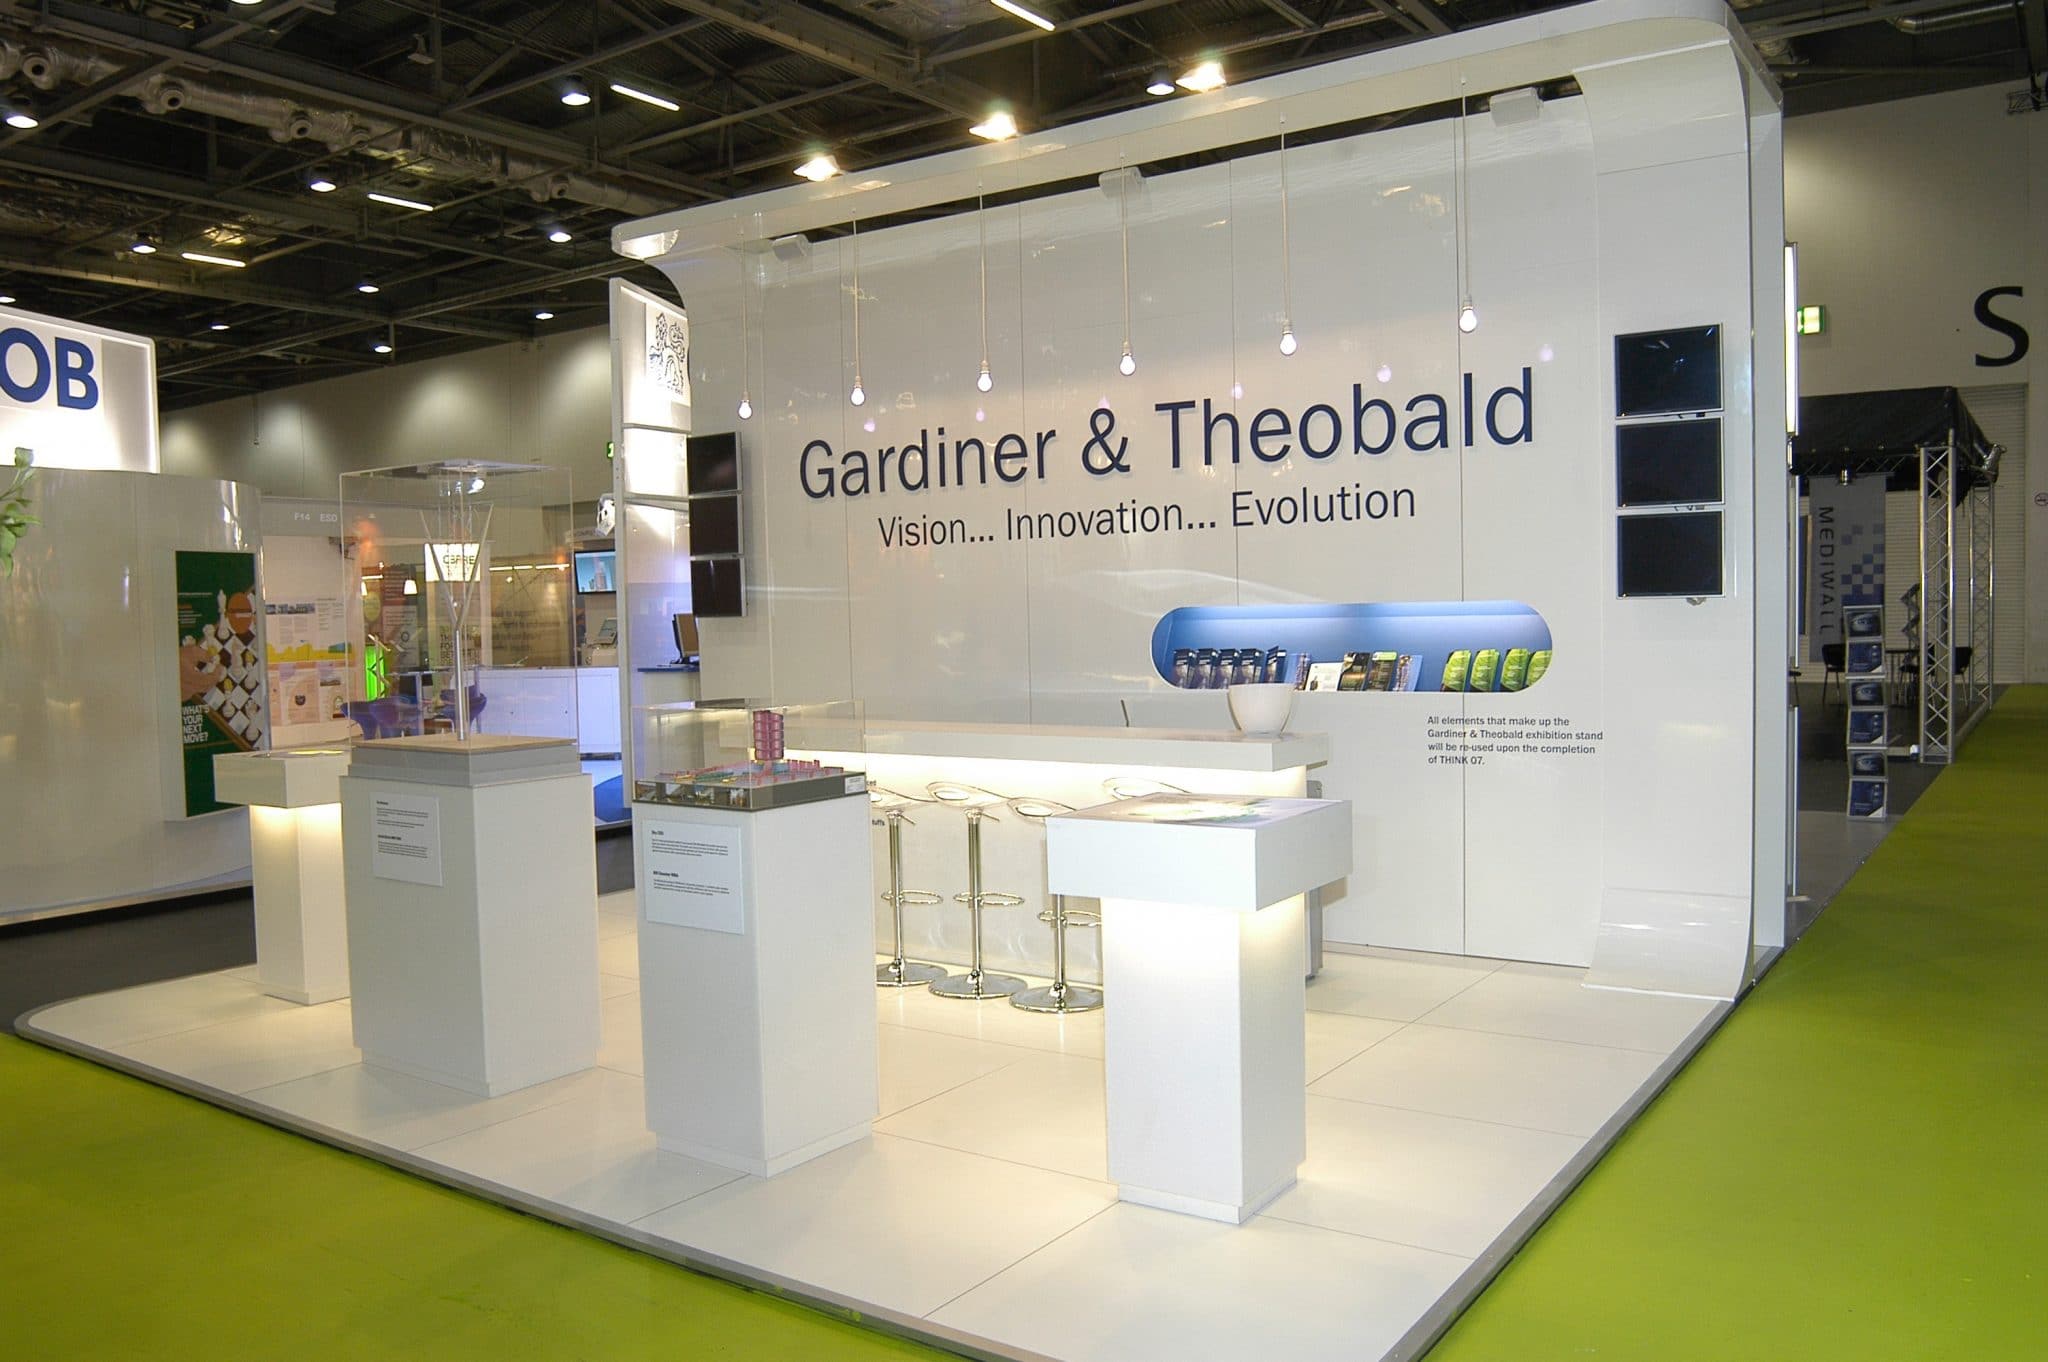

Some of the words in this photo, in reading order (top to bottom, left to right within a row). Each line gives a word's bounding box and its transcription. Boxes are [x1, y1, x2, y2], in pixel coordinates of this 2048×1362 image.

[1974, 286, 2029, 367] S
[0, 327, 99, 411] OB
[800, 426, 1057, 499] Gardiner
[1081, 407, 1131, 475] &
[1154, 366, 1533, 469] Theobald
[877, 513, 995, 548] Vision...
[1006, 499, 1216, 540] Innovation...
[1231, 482, 1415, 527] Evolution
[1818, 506, 1836, 635] MEDIWALL
[183, 704, 209, 715] WHAT'S
[182, 713, 203, 726] YOUR
[1427, 715, 1440, 725] All
[1441, 716, 1485, 726] elements
[1487, 716, 1506, 726] that
[1508, 716, 1536, 726] make
[1538, 717, 1552, 728] up
[1553, 716, 1570, 726] the
[183, 723, 202, 735] NEXT
[1427, 728, 1467, 739] Gardiner
[1469, 729, 1478, 739] &
[1480, 729, 1523, 739] Theobald
[1525, 730, 1573, 740] exhibition
[1575, 731, 1604, 741] stand
[184, 732, 208, 743] MOVE?
[1427, 742, 1444, 752] will
[1445, 742, 1458, 752] be
[1459, 743, 1494, 752] re-used
[1496, 744, 1520, 755] upon
[1522, 744, 1539, 753] the
[1540, 744, 1596, 755] completion
[1427, 755, 1438, 764] of
[1439, 755, 1469, 765] THINK
[1470, 756, 1486, 765] 07.
